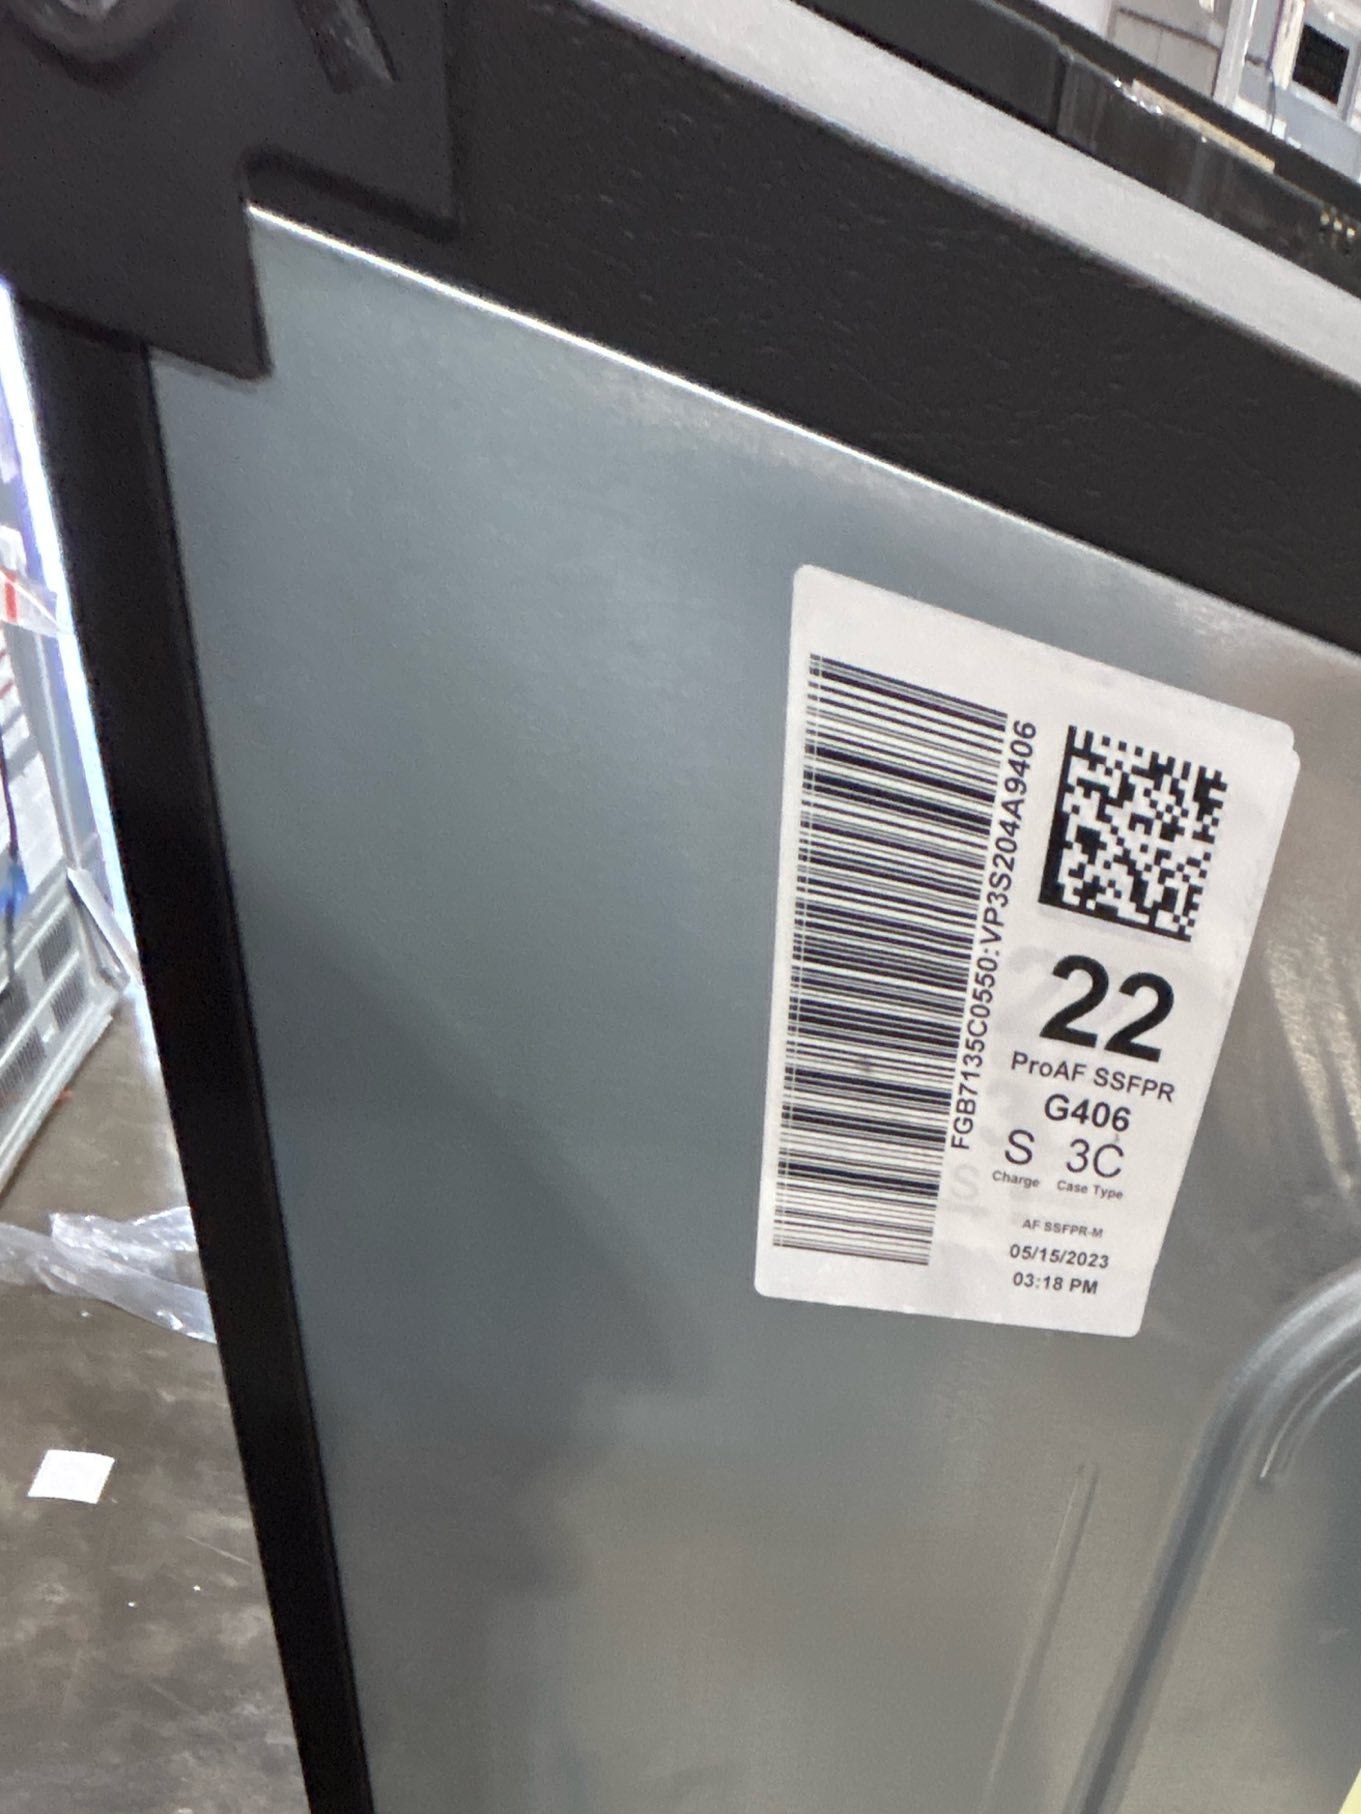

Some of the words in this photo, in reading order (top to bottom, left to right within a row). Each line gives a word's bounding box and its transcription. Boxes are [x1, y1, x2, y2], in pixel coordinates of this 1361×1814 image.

[951, 719, 1037, 1150] FGB7135C0550:VP3S204A9406
[1039, 955, 1175, 1063] 22
[1011, 1051, 1087, 1082] ProAF
[1094, 1067, 1176, 1102] SSFPR
[1044, 1094, 1131, 1132] G406
[1005, 1129, 1035, 1165] S
[1066, 1139, 1125, 1178] 3C
[992, 1170, 1041, 1190] Charge
[1057, 1180, 1089, 1196] Case
[1093, 1185, 1124, 1201] Type
[1022, 1219, 1041, 1231] AF
[1044, 1221, 1104, 1239] SSFPR-M
[1009, 1244, 1110, 1269] 05/15/2023
[1013, 1272, 1063, 1292] 03:18
[1069, 1277, 1098, 1295] PM
